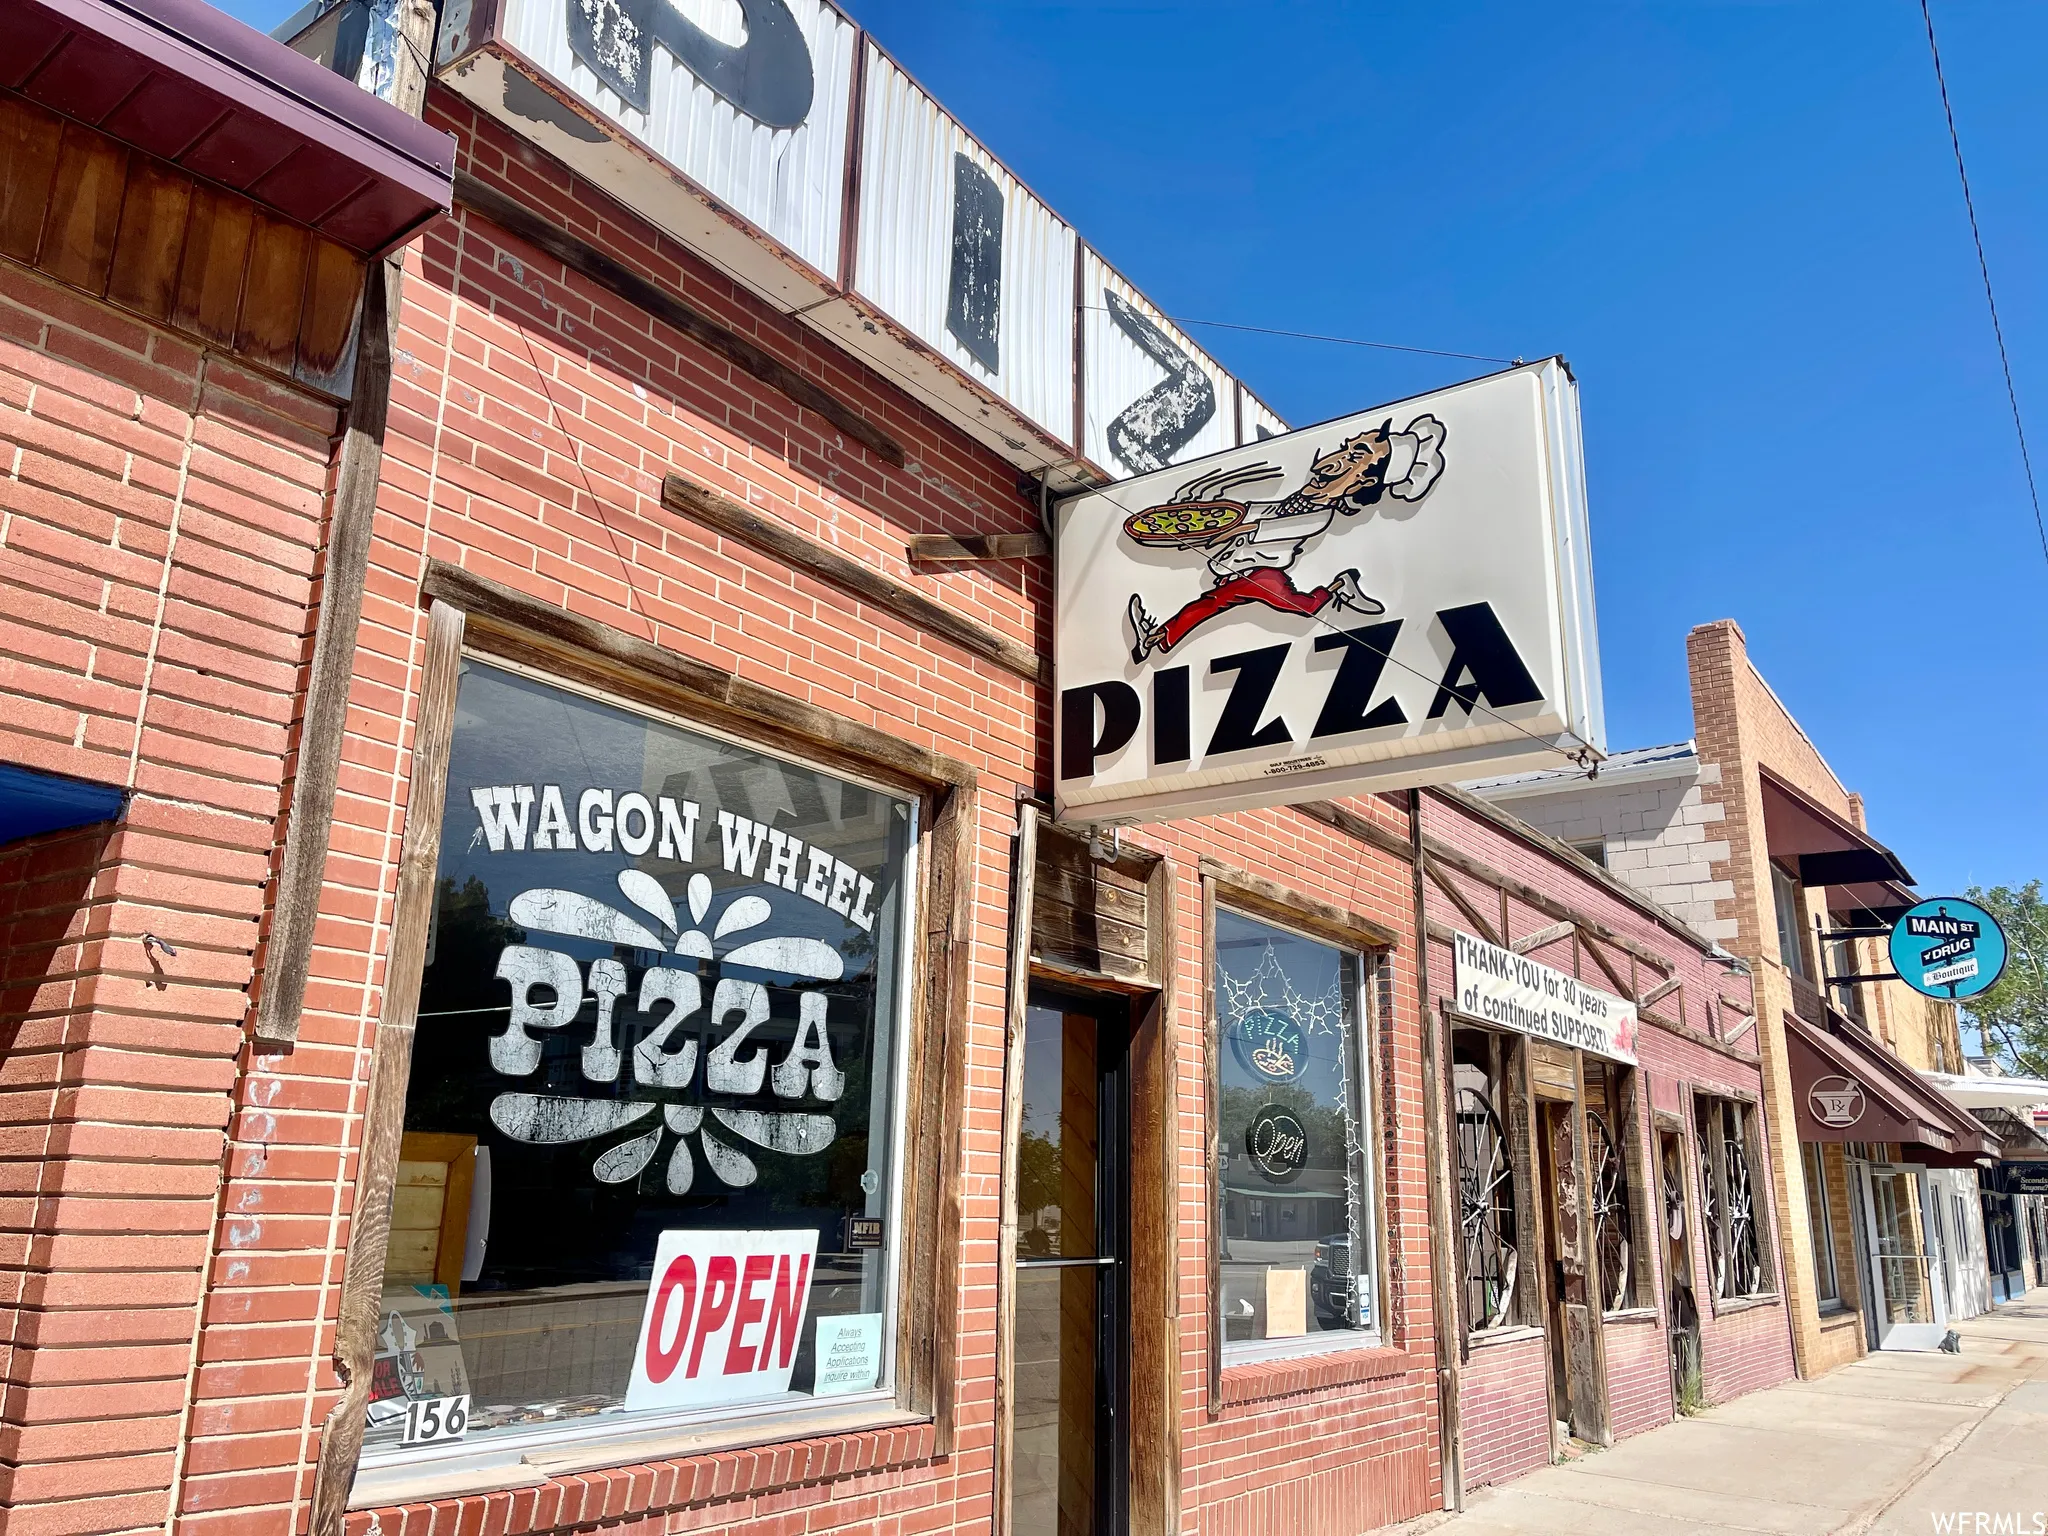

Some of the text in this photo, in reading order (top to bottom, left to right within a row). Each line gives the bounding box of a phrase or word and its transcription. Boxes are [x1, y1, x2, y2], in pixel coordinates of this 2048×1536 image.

[1061, 601, 1546, 780] PIZZA
[469, 783, 878, 933] WAGON WHEEL
[1911, 918, 1974, 934] MAIN ST
[1932, 938, 1971, 959] DRUG
[1456, 933, 1608, 1018] THANK-YOU for 30 years
[1932, 963, 1975, 981] Boutique
[488, 945, 845, 1101] PIZZA
[1244, 1015, 1299, 1055] PIZZA
[1464, 984, 1609, 1053] of continued SUPPORT!
[1254, 1118, 1304, 1164] Open
[645, 1253, 810, 1384] OPEN
[837, 1327, 862, 1339] Always
[826, 1356, 869, 1368] Applications
[831, 1342, 866, 1354] Accepting
[374, 1361, 390, 1377] OR
[824, 1369, 871, 1383] Inquire within
[407, 1397, 466, 1441] 156
